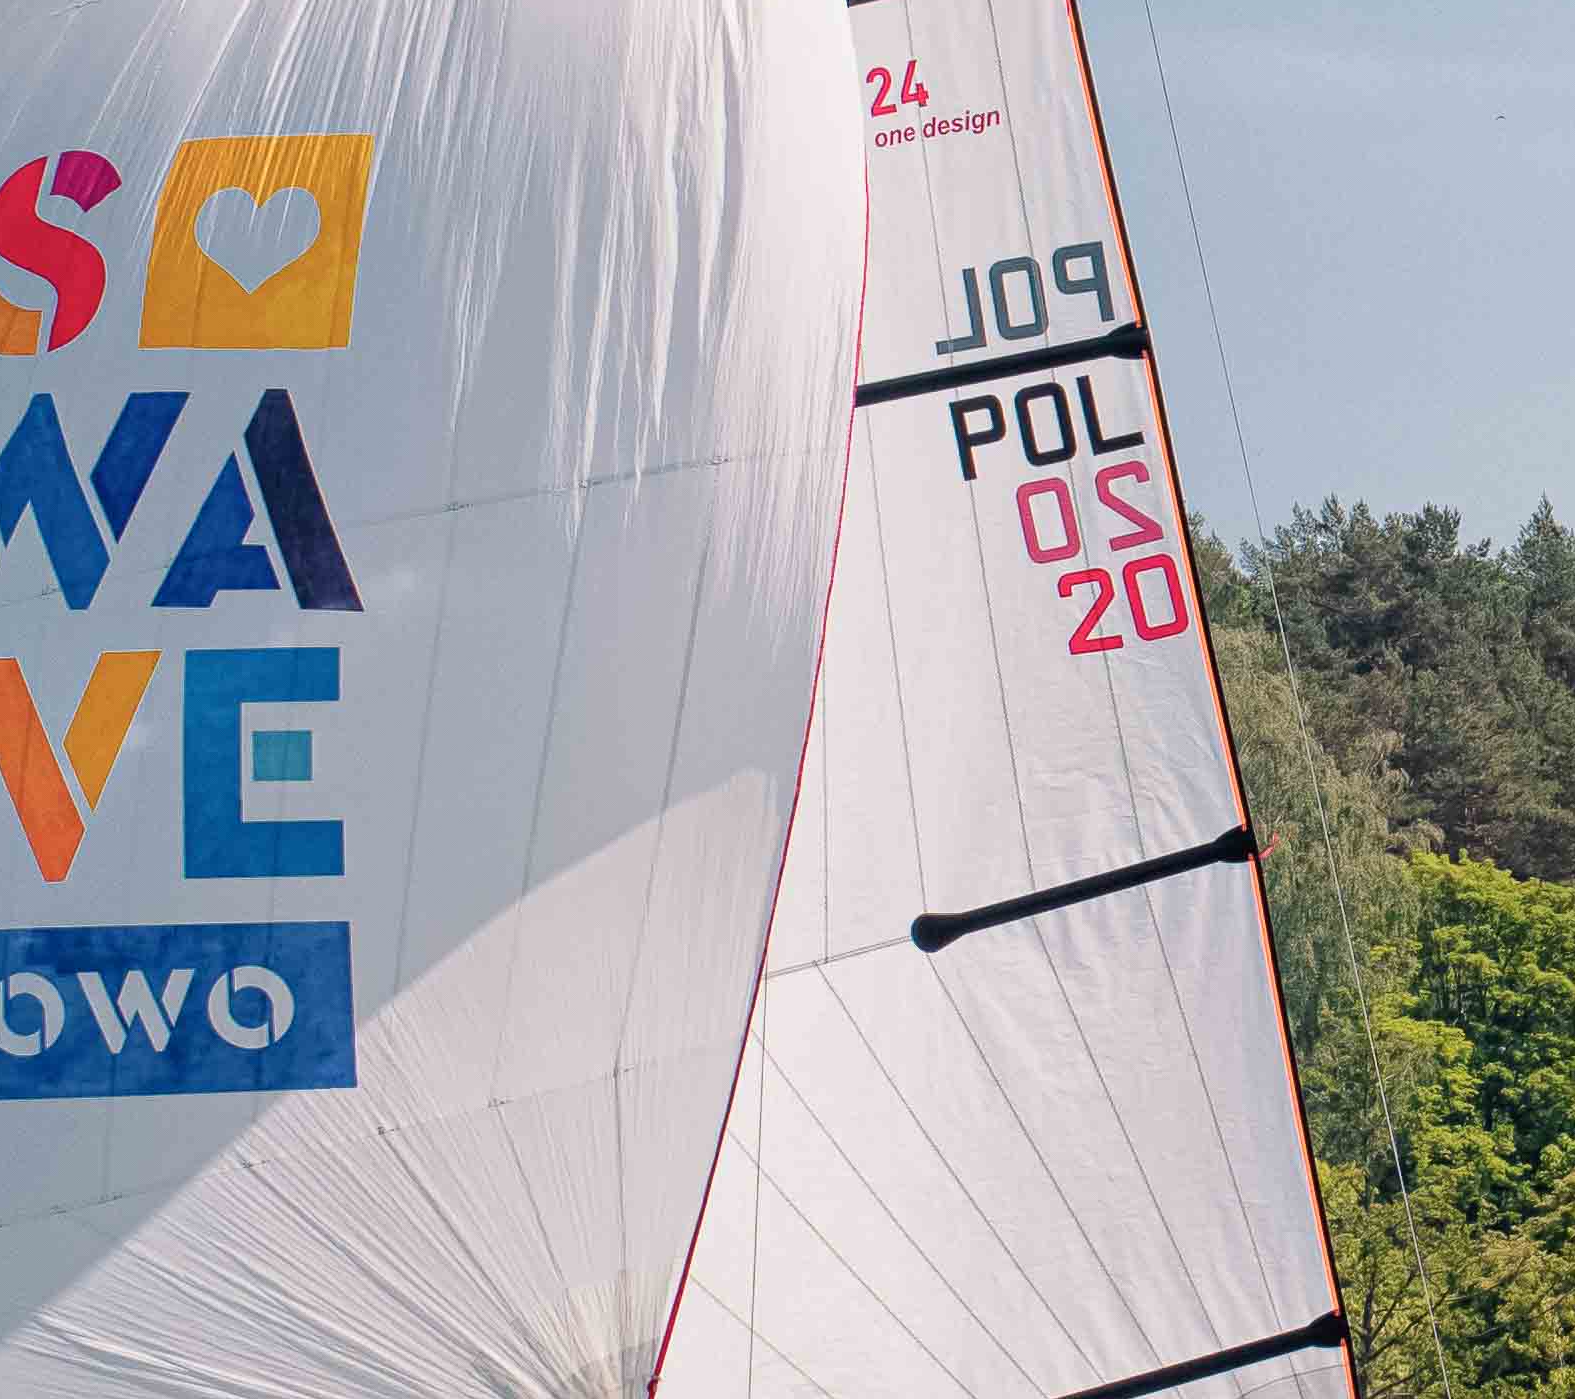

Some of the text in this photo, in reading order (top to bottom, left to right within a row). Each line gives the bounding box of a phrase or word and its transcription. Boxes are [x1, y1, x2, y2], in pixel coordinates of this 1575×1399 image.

[865, 58, 930, 118] 24
[874, 108, 1001, 148] one design
[949, 374, 1146, 482] POL
[1057, 553, 1189, 656] 20
